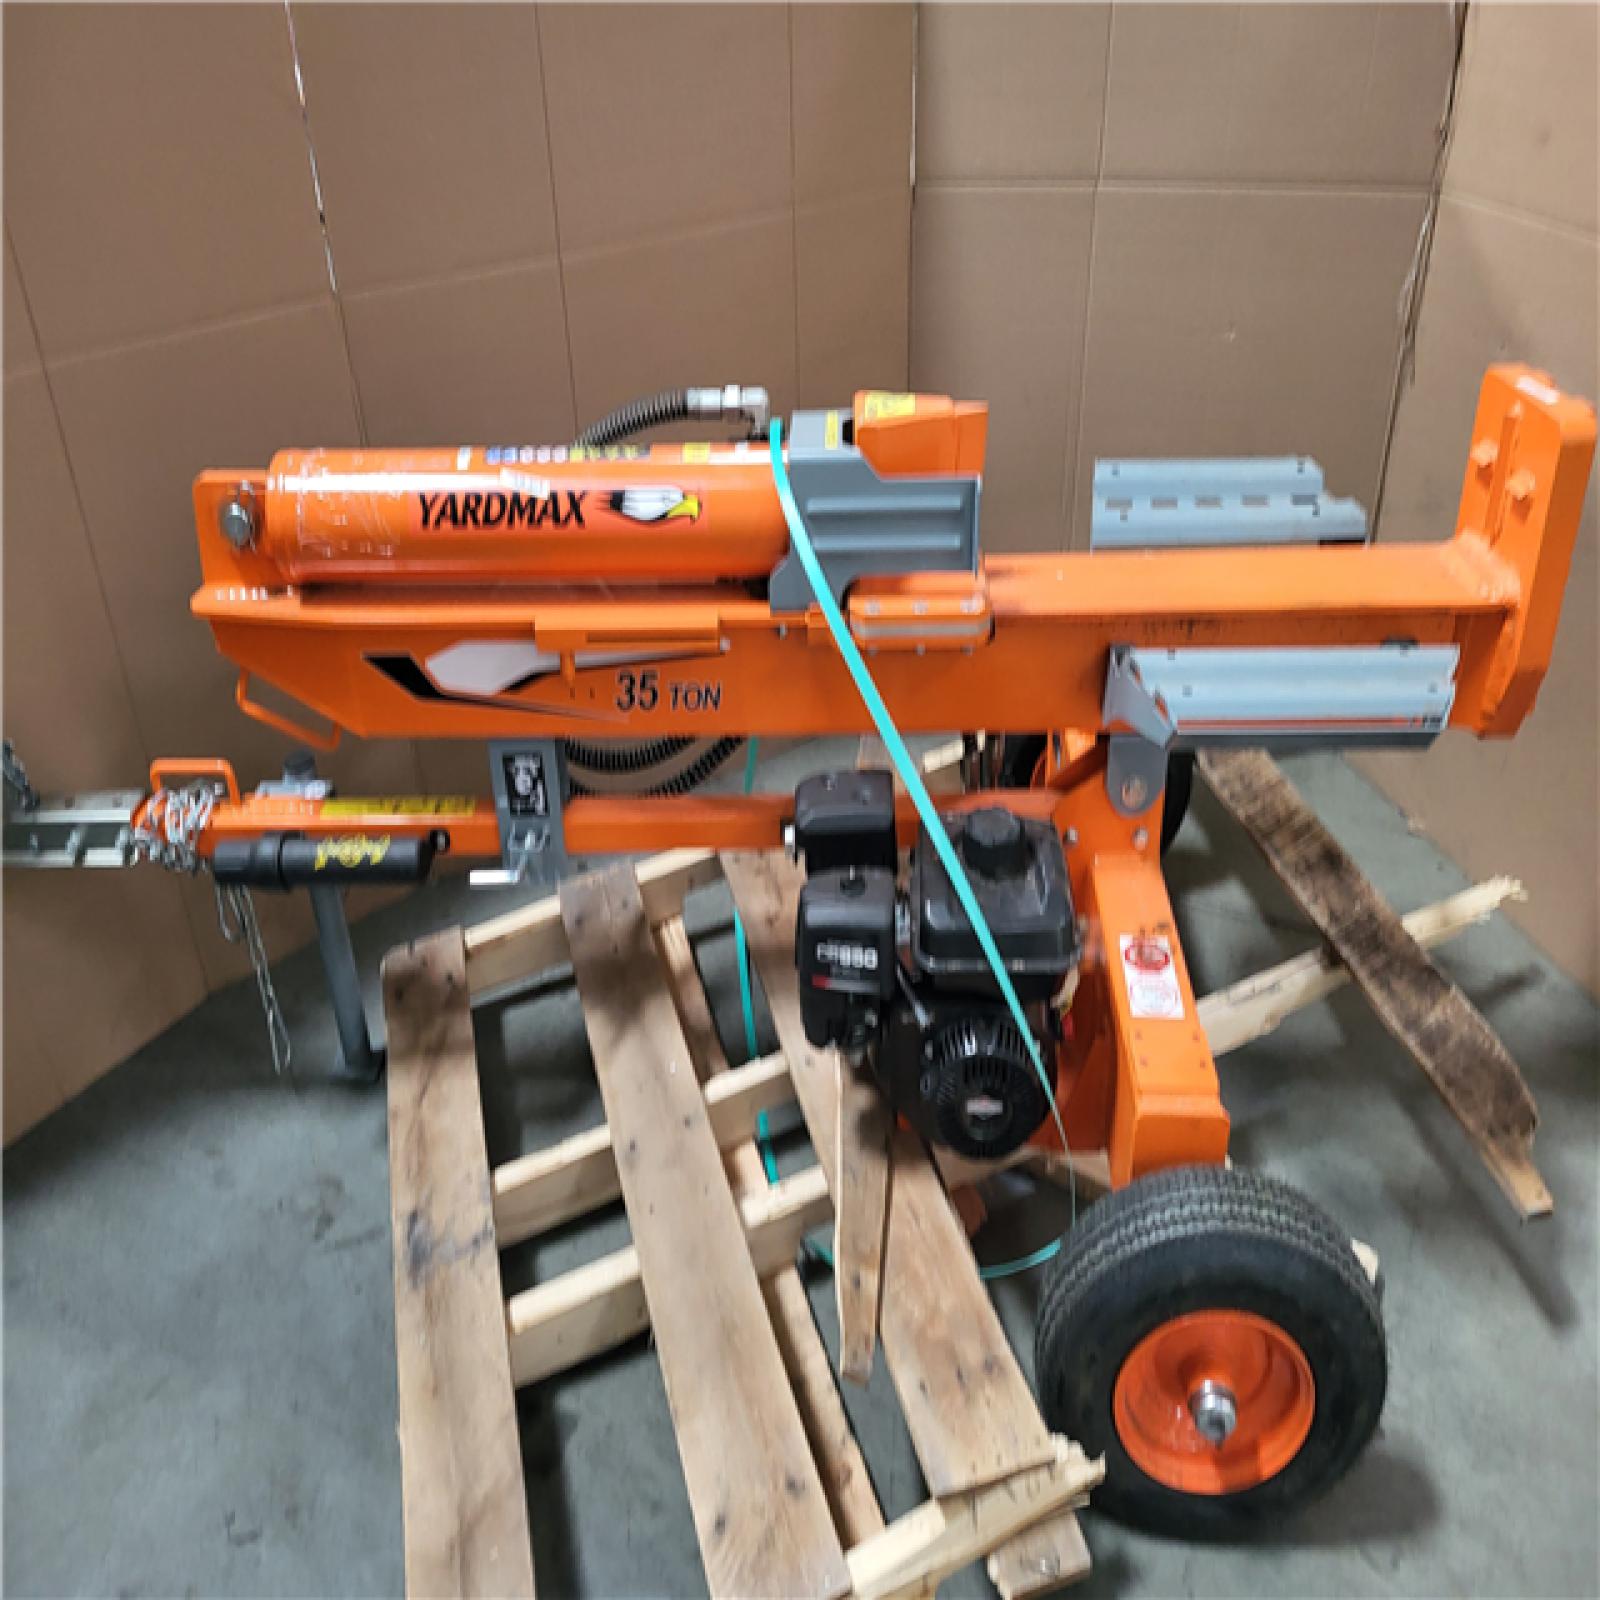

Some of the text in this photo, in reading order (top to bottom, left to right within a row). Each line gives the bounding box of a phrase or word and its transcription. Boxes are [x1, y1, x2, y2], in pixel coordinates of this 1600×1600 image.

[419, 489, 588, 530] YARDMAX
[616, 669, 721, 711] 35 TON
